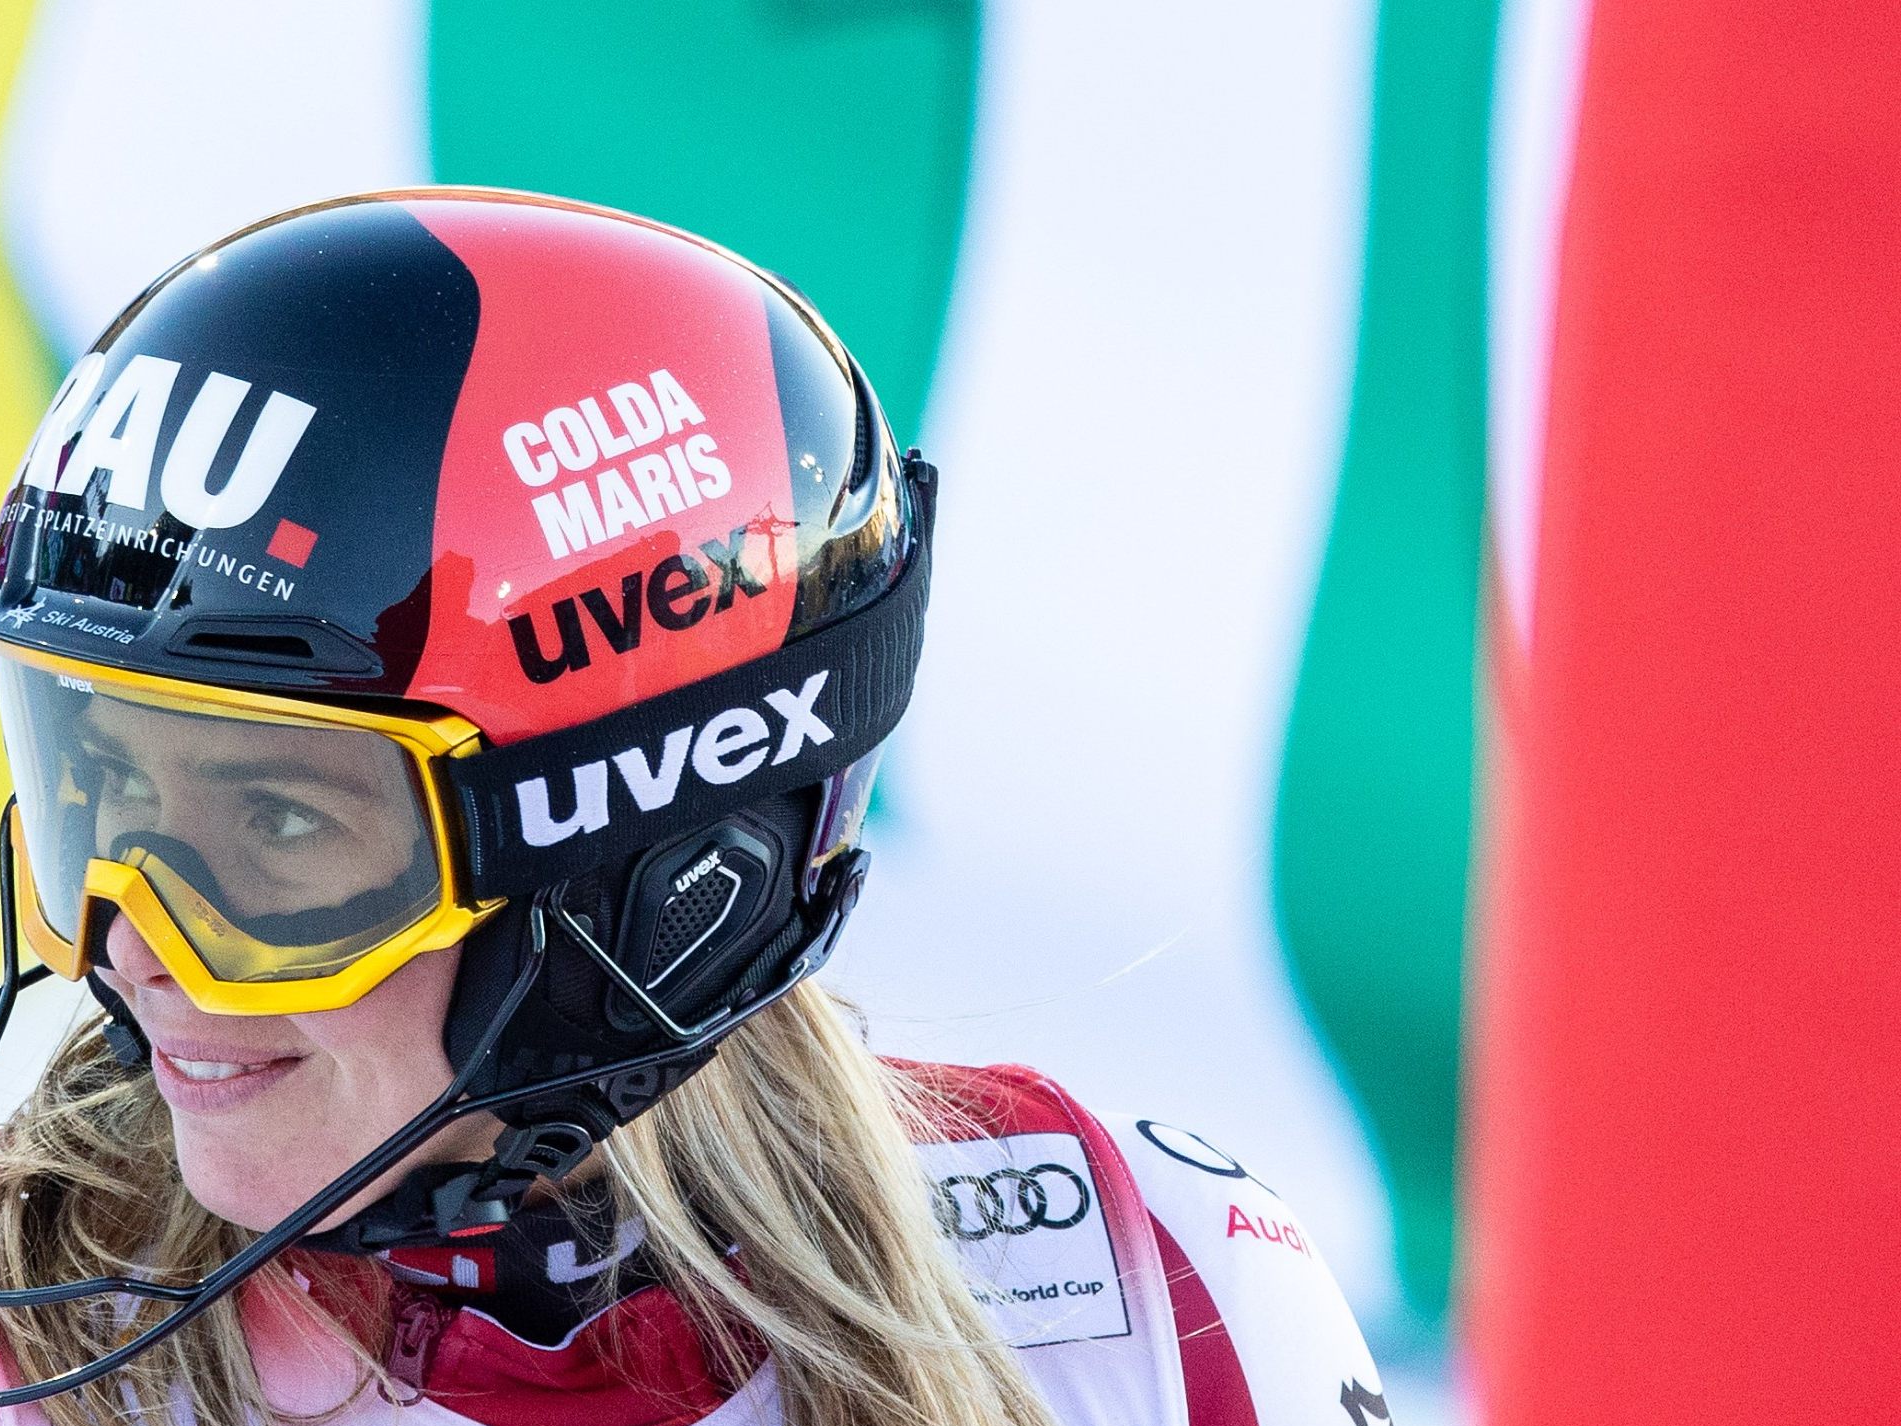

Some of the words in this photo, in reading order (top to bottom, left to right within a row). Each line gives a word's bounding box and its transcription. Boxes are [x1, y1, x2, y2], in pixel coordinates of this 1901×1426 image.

[502, 368, 706, 488] COLDA
[531, 433, 732, 560] MARIS
[41, 610, 75, 626] Ski
[68, 617, 135, 645] Austria
[506, 527, 767, 685] uvex
[58, 674, 95, 695] uvex
[515, 670, 835, 847] uvex
[675, 851, 721, 892] uvex
[1063, 1280, 1104, 1296] Cup
